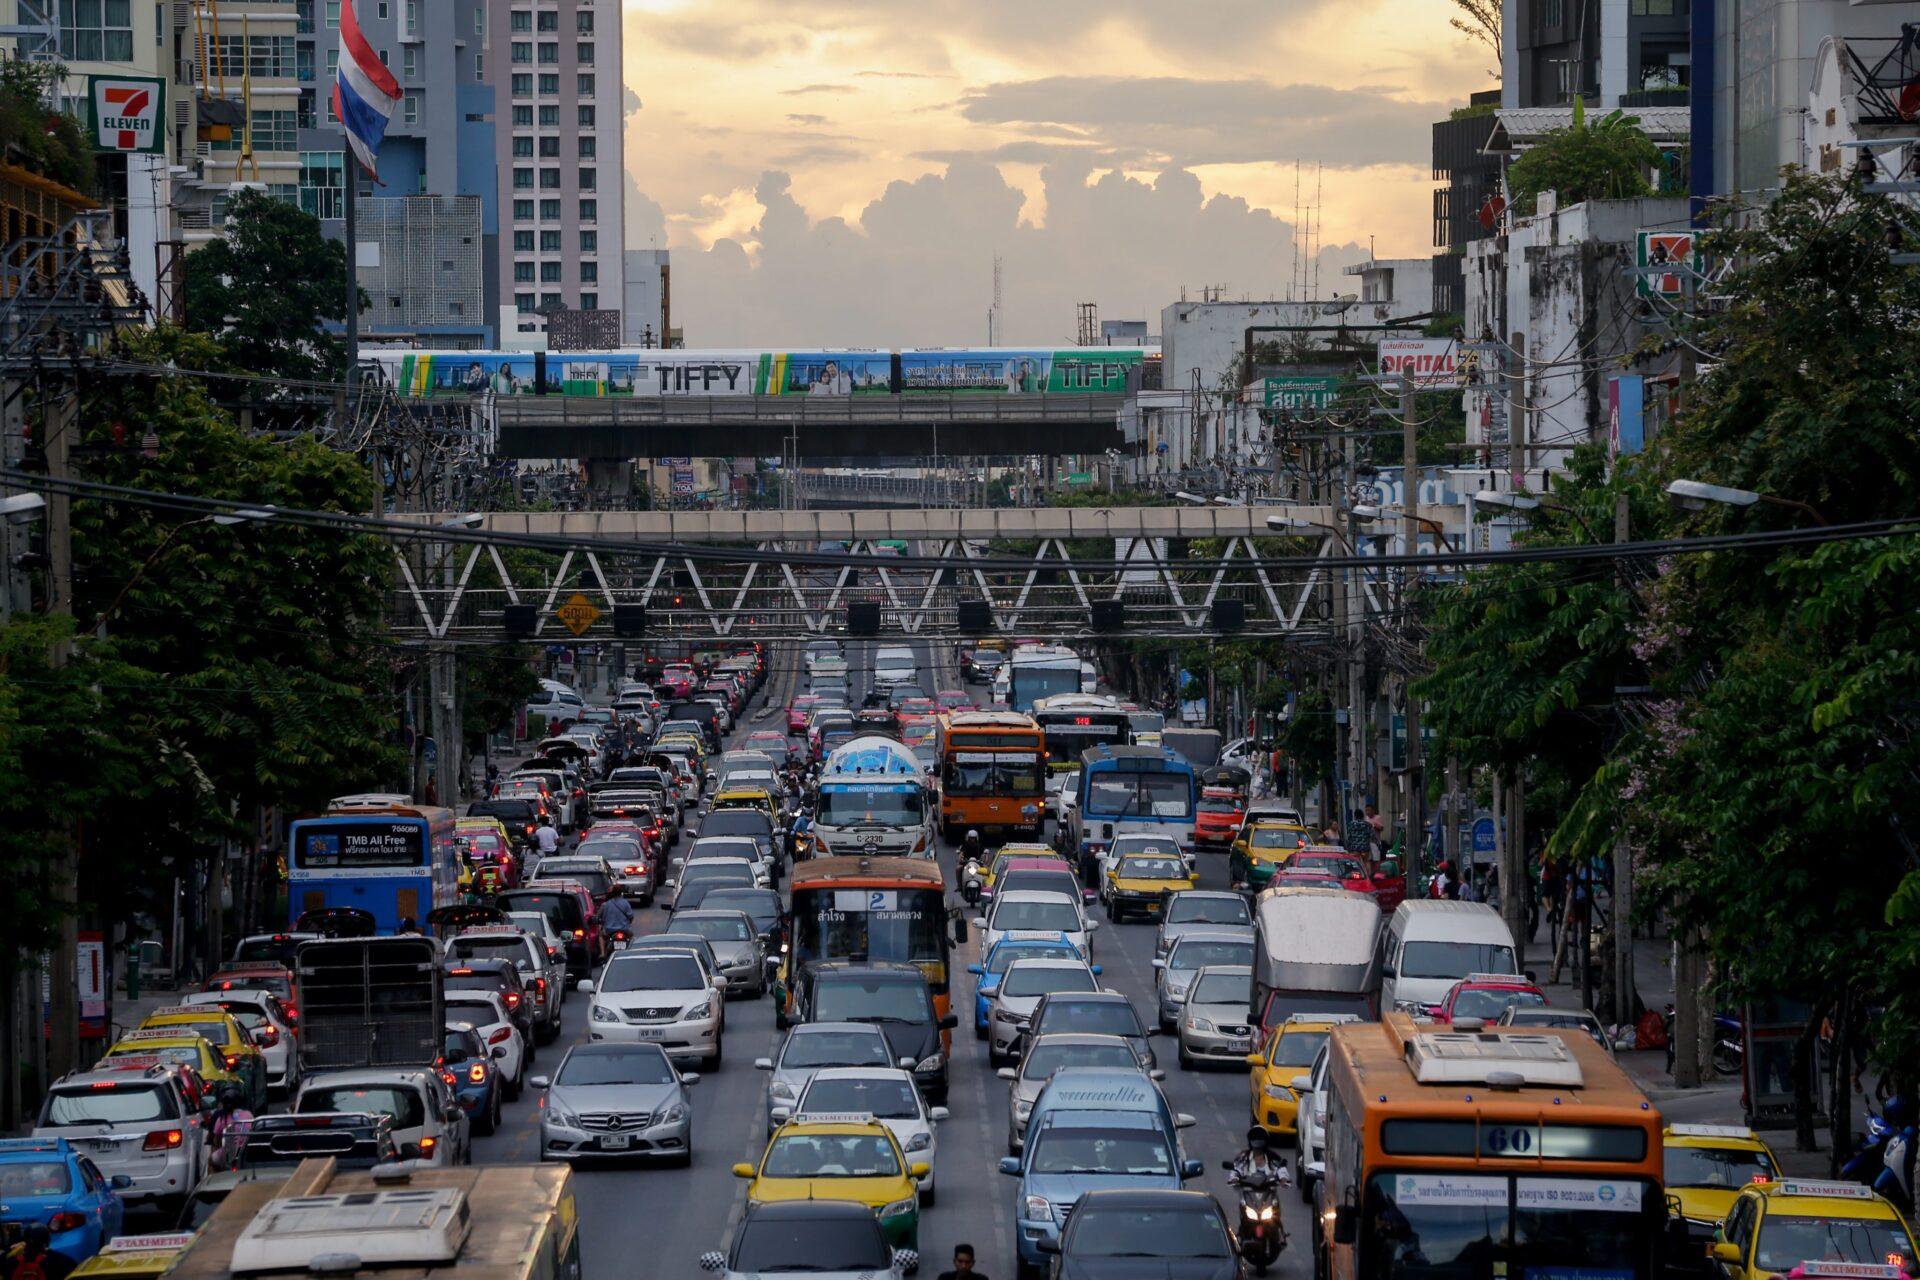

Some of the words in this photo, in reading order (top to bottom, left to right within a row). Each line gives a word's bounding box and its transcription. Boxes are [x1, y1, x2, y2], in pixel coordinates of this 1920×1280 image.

[105, 88, 149, 149] 7
[1380, 354, 1456, 373] DIGITAL
[655, 366, 742, 391] TIFFY
[346, 836, 368, 846] TMB
[370, 836, 382, 845] All
[385, 835, 406, 845] Free
[869, 892, 886, 910] 2
[817, 908, 845, 922] สำโรง
[876, 911, 922, 920] สนามหลวง
[1488, 1127, 1532, 1153] 60
[1546, 1190, 1558, 1200] ISO
